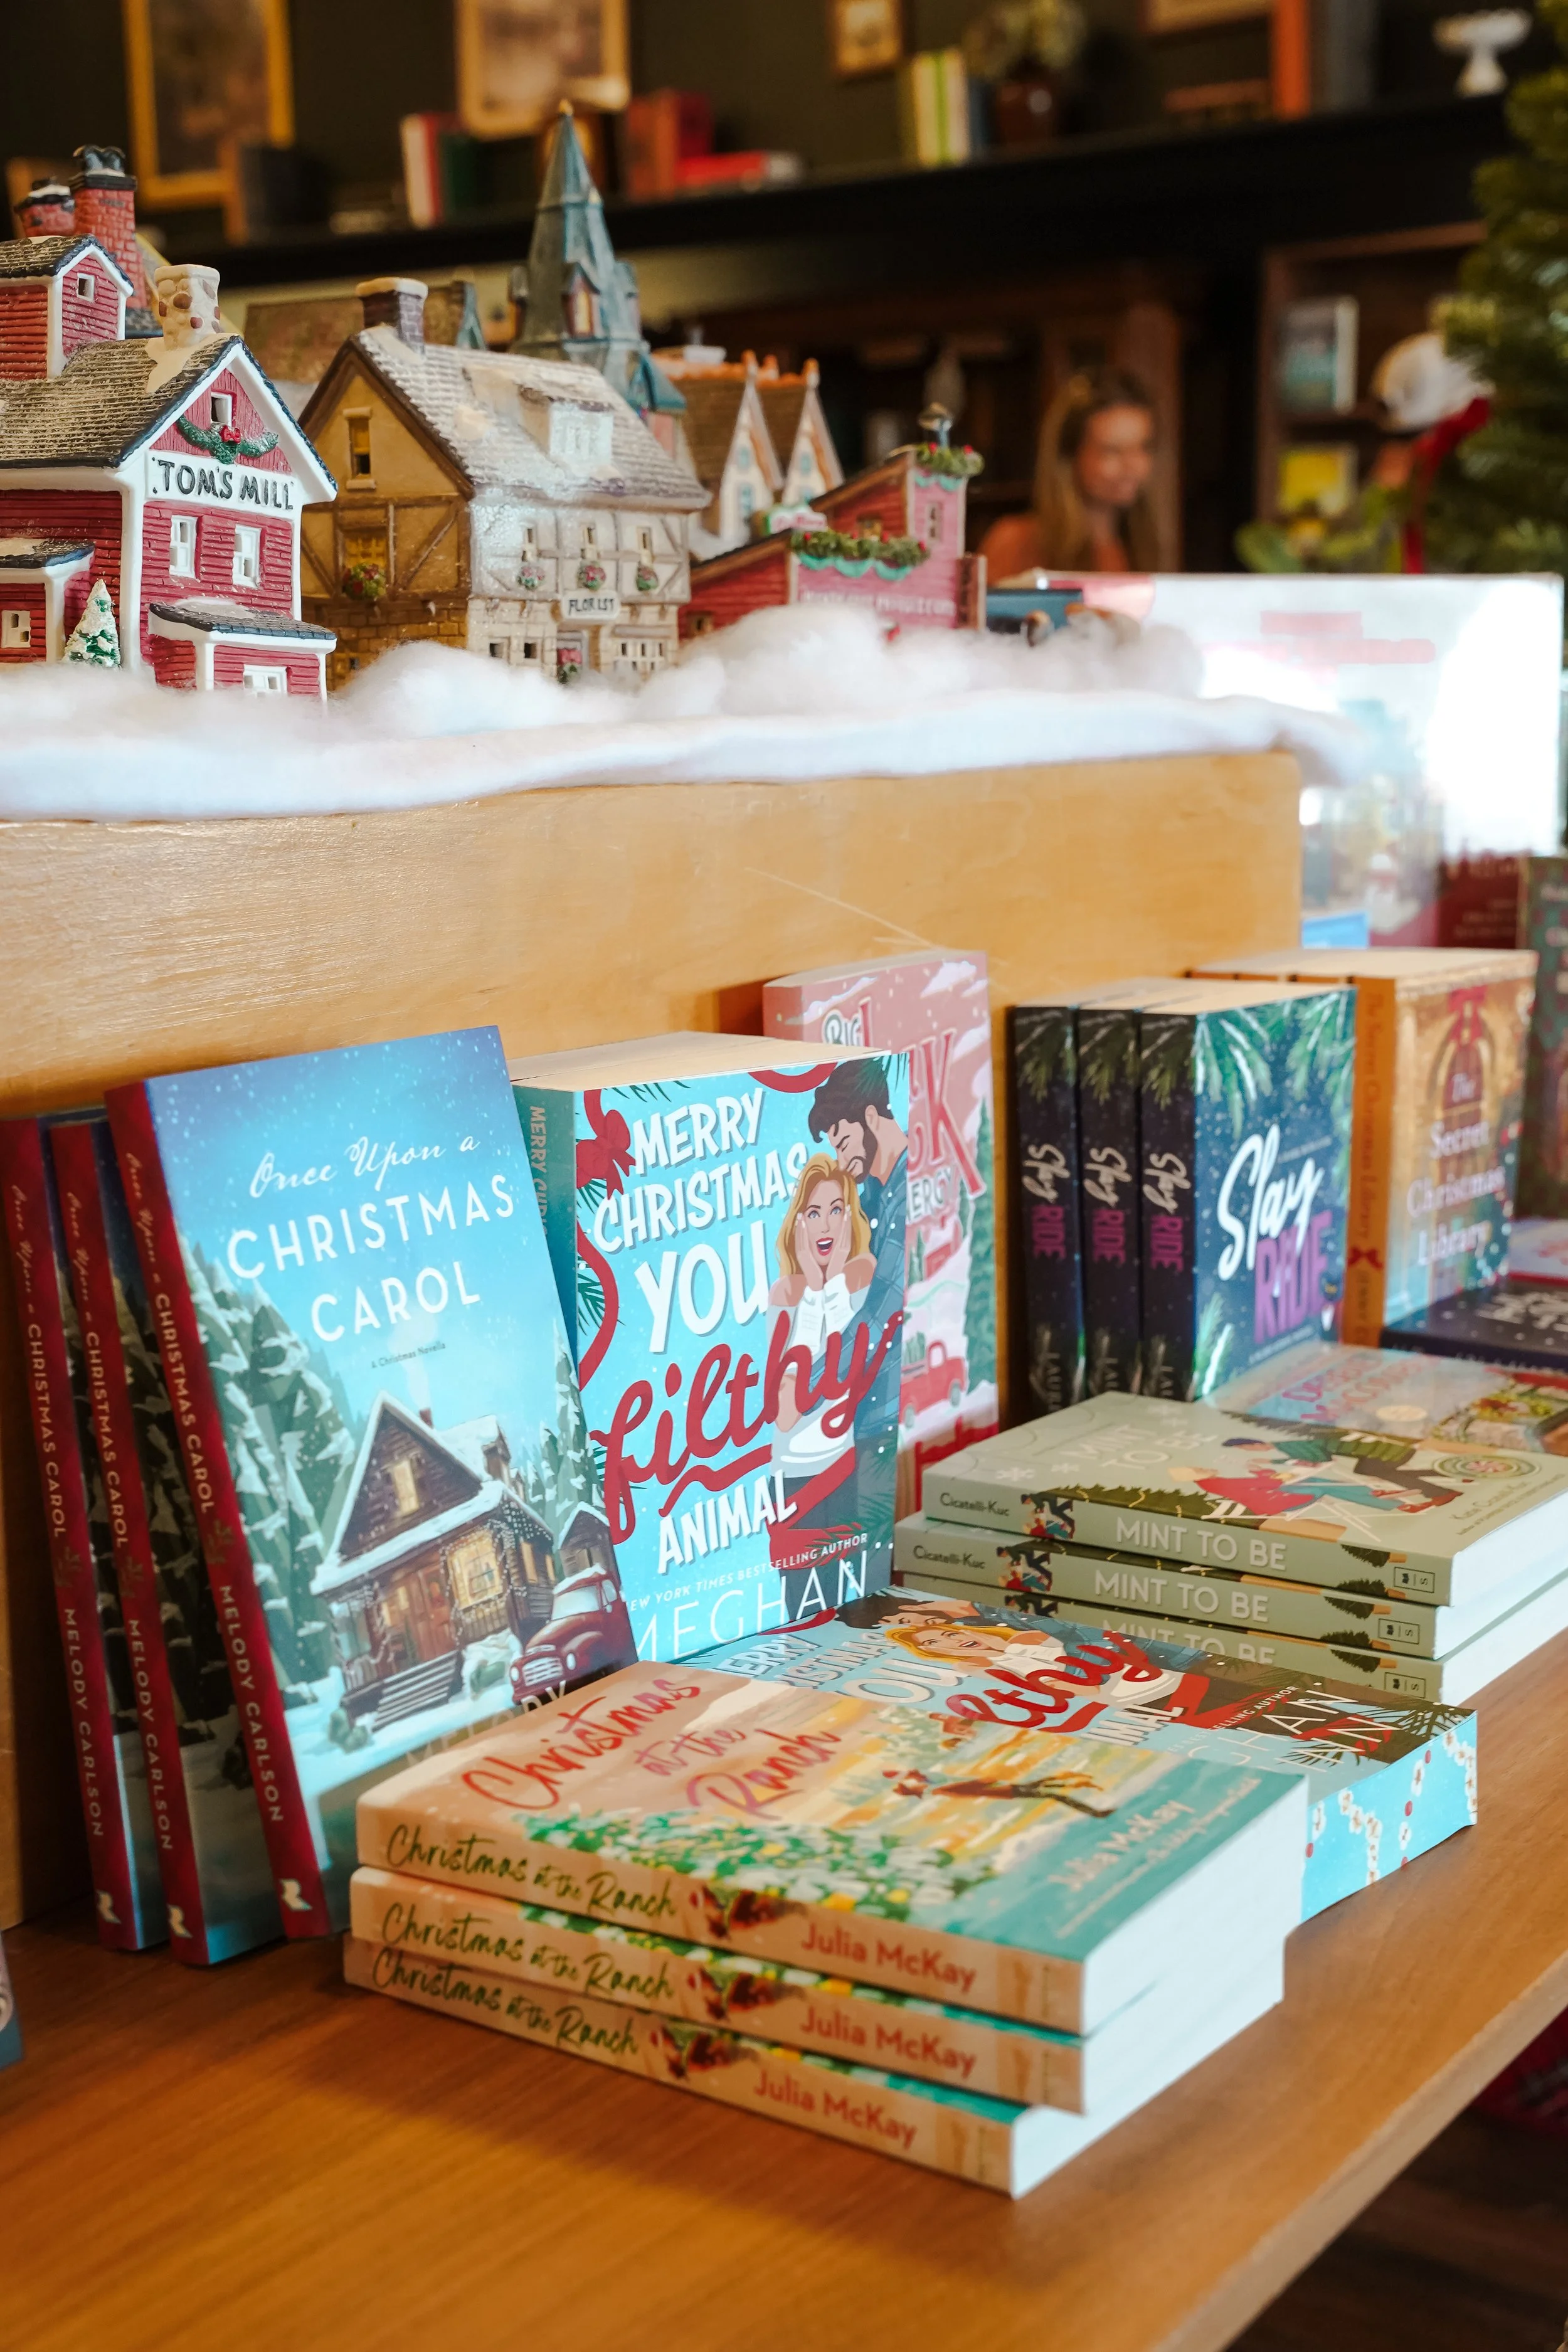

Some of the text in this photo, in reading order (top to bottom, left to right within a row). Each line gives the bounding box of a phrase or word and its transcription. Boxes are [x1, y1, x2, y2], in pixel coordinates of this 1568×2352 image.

[158, 459, 294, 510] TOM'S MILL
[569, 598, 613, 615] FLORIST
[249, 1135, 480, 1198] Once Upon a
[530, 1106, 547, 1173] MERRY
[634, 1088, 765, 1176] MERRY
[227, 1173, 514, 1279] CHRISTMAS
[593, 1143, 808, 1253] CHRISTMAS
[907, 1168, 956, 1217] ERGY
[1022, 1143, 1070, 1260] Slay RIDE
[1083, 1146, 1132, 1264] Slay RIDE
[1143, 1152, 1191, 1273] Slay RIDE
[1217, 1124, 1325, 1281] Slay
[1407, 1165, 1506, 1217] Christmas
[634, 1220, 769, 1353] YOU
[1417, 1221, 1491, 1266] Library
[311, 1261, 480, 1342] CAROL
[154, 1292, 196, 1426] CHRISTMAS
[187, 1434, 215, 1514] CAROL
[378, 1352, 416, 1367] Christmas
[28, 1323, 56, 1453] CHRISTMAS
[45, 1461, 68, 1537] CAROL
[85, 1332, 117, 1462] CHRISTMAS
[107, 1469, 128, 1548] CAROL
[590, 1310, 903, 1545] filthy
[658, 1470, 797, 1575] ANIMAL
[1116, 1517, 1286, 1571] MINT TO BE
[627, 1533, 867, 1612] EW YORK TIMES BESTSELLING AUTHOR
[1094, 1569, 1268, 1623] MINT TO BE
[714, 1634, 822, 1677] ERRY
[837, 1658, 972, 1705] OU
[945, 1629, 1164, 1729] lthy
[1254, 1685, 1300, 1710] AUTHOR
[64, 1608, 104, 1836] MELODY CARLSON
[129, 1619, 173, 1850] MELODY CARLSON
[220, 1585, 284, 1821] MELODY CARLSON
[462, 1678, 701, 1809] Christmas
[1080, 1704, 1184, 1746] IMAL
[633, 1727, 747, 1776] at the
[686, 1726, 842, 1819] Ranch
[386, 1824, 527, 1883] Christmas
[586, 1870, 676, 1919] Ranch
[381, 1902, 523, 1962] Christmas
[583, 1952, 674, 1999] Ranch
[801, 1922, 977, 1994] Julia McKay
[373, 1947, 502, 2011] Christmas
[554, 2006, 638, 2055] Ranch
[800, 2006, 977, 2080] Julia McKay
[754, 2070, 917, 2149] Julia McKay
